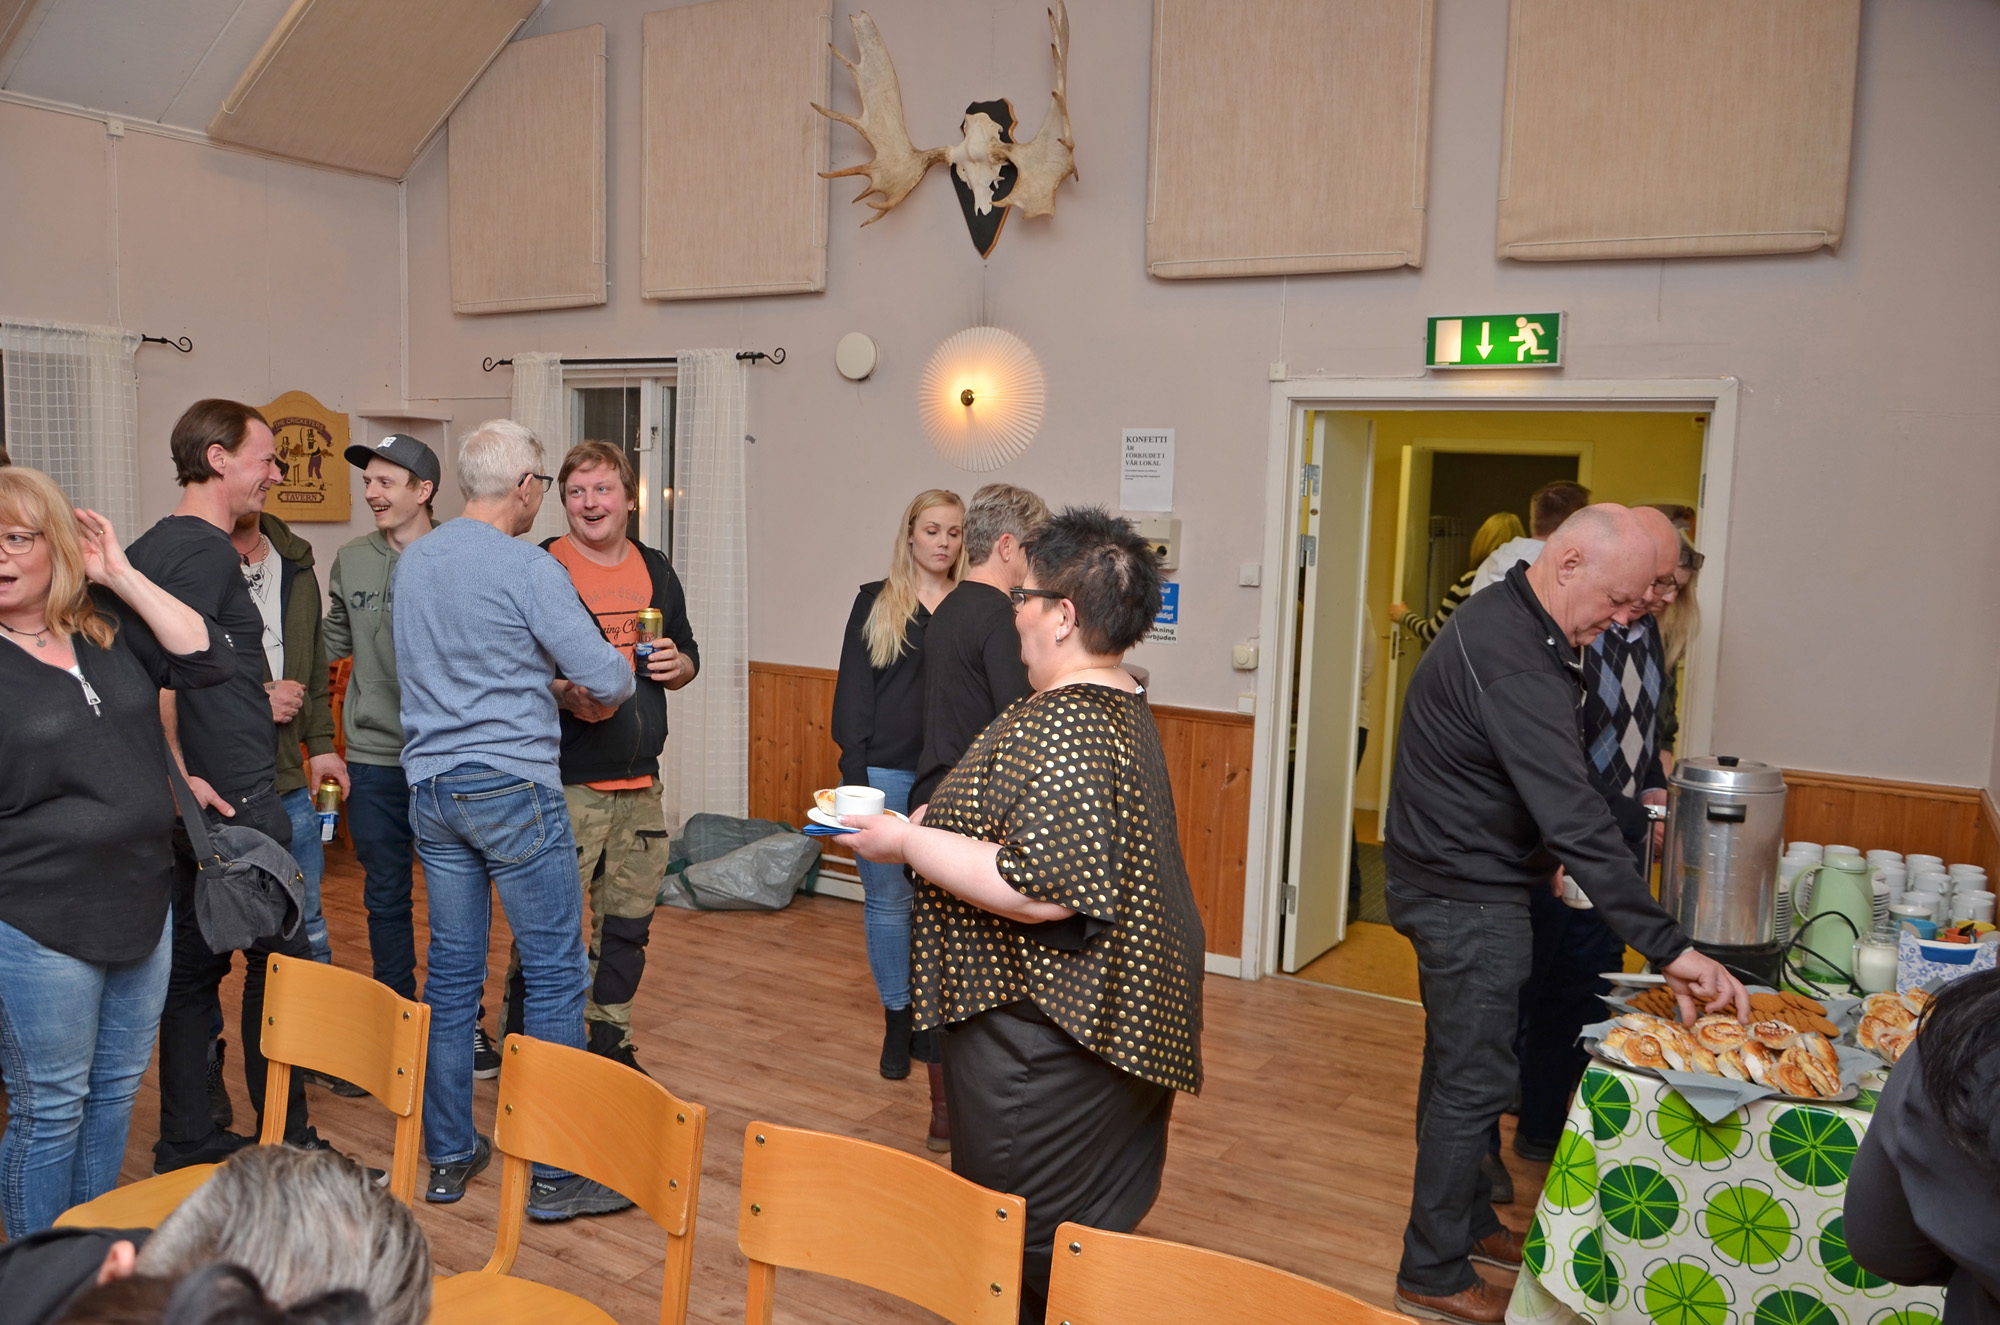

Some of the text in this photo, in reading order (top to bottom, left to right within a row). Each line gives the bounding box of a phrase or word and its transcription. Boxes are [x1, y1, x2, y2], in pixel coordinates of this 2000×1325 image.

[274, 418, 324, 431] THE CRICKETERS
[285, 493, 318, 501] TAVERN
[585, 587, 645, 605] ORTH BEND
